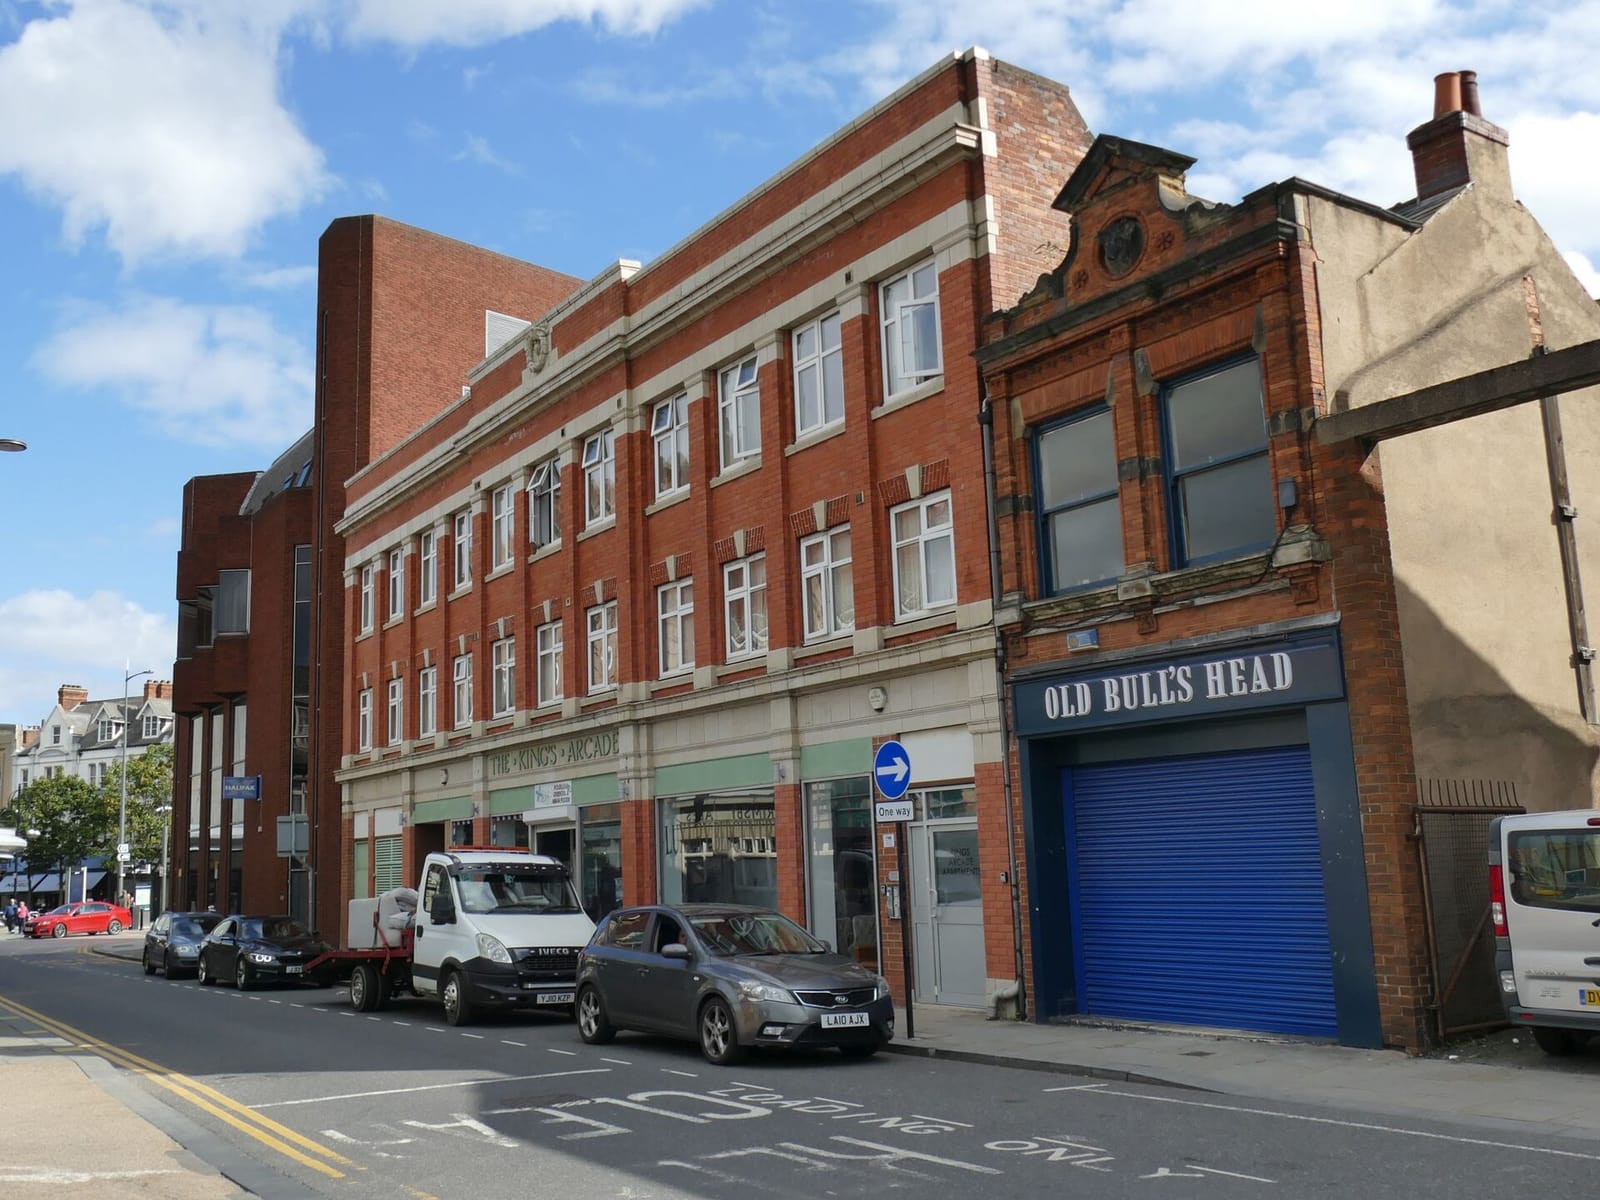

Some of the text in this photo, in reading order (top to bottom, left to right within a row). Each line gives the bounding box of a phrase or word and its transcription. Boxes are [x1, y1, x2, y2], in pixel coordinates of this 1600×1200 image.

[1044, 652, 1293, 719] OLD BULL'S HEAD
[490, 731, 620, 776] THE KING'S ARCADE
[879, 806, 911, 818] One way
[539, 948, 569, 956] IVECO
[558, 994, 571, 1002] KZP
[827, 1014, 865, 1025] LA10 AJX
[707, 1086, 955, 1135] LOADING
[983, 1139, 1205, 1178] ONLY
